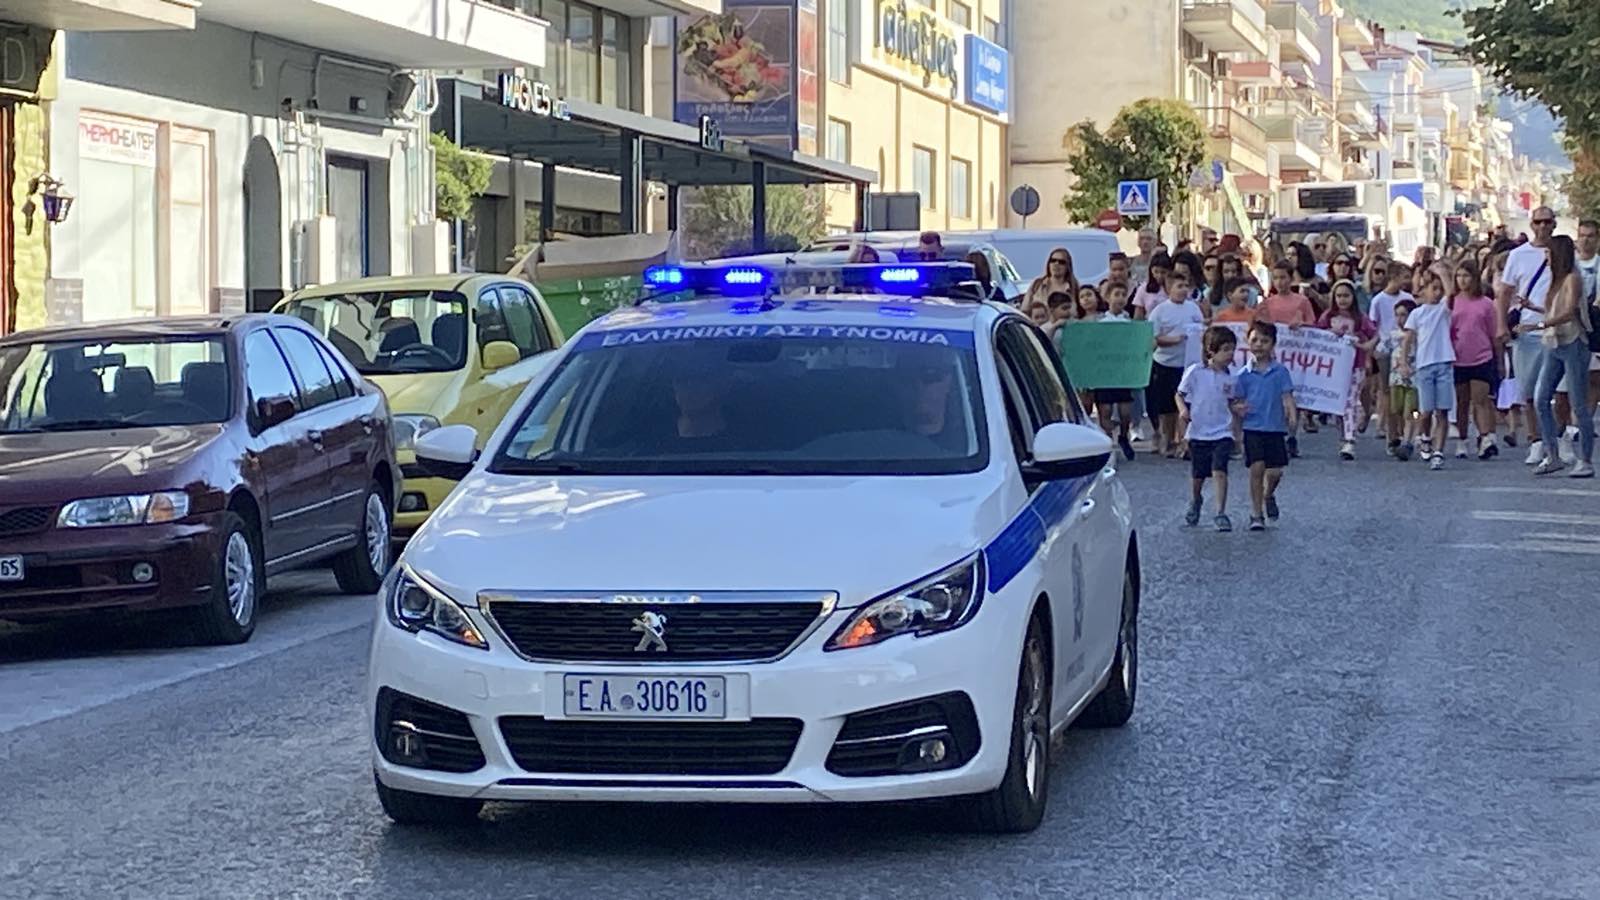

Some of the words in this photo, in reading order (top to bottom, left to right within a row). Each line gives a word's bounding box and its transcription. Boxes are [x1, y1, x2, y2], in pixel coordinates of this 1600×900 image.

[503, 73, 551, 116] MAGNES
[601, 326, 758, 347] ΕΛΛΗΝΙΚΗ
[765, 325, 949, 346] ΑΣΤΥΝΟΜΙΑ
[1, 559, 19, 576] 65
[637, 680, 707, 712] 30616
